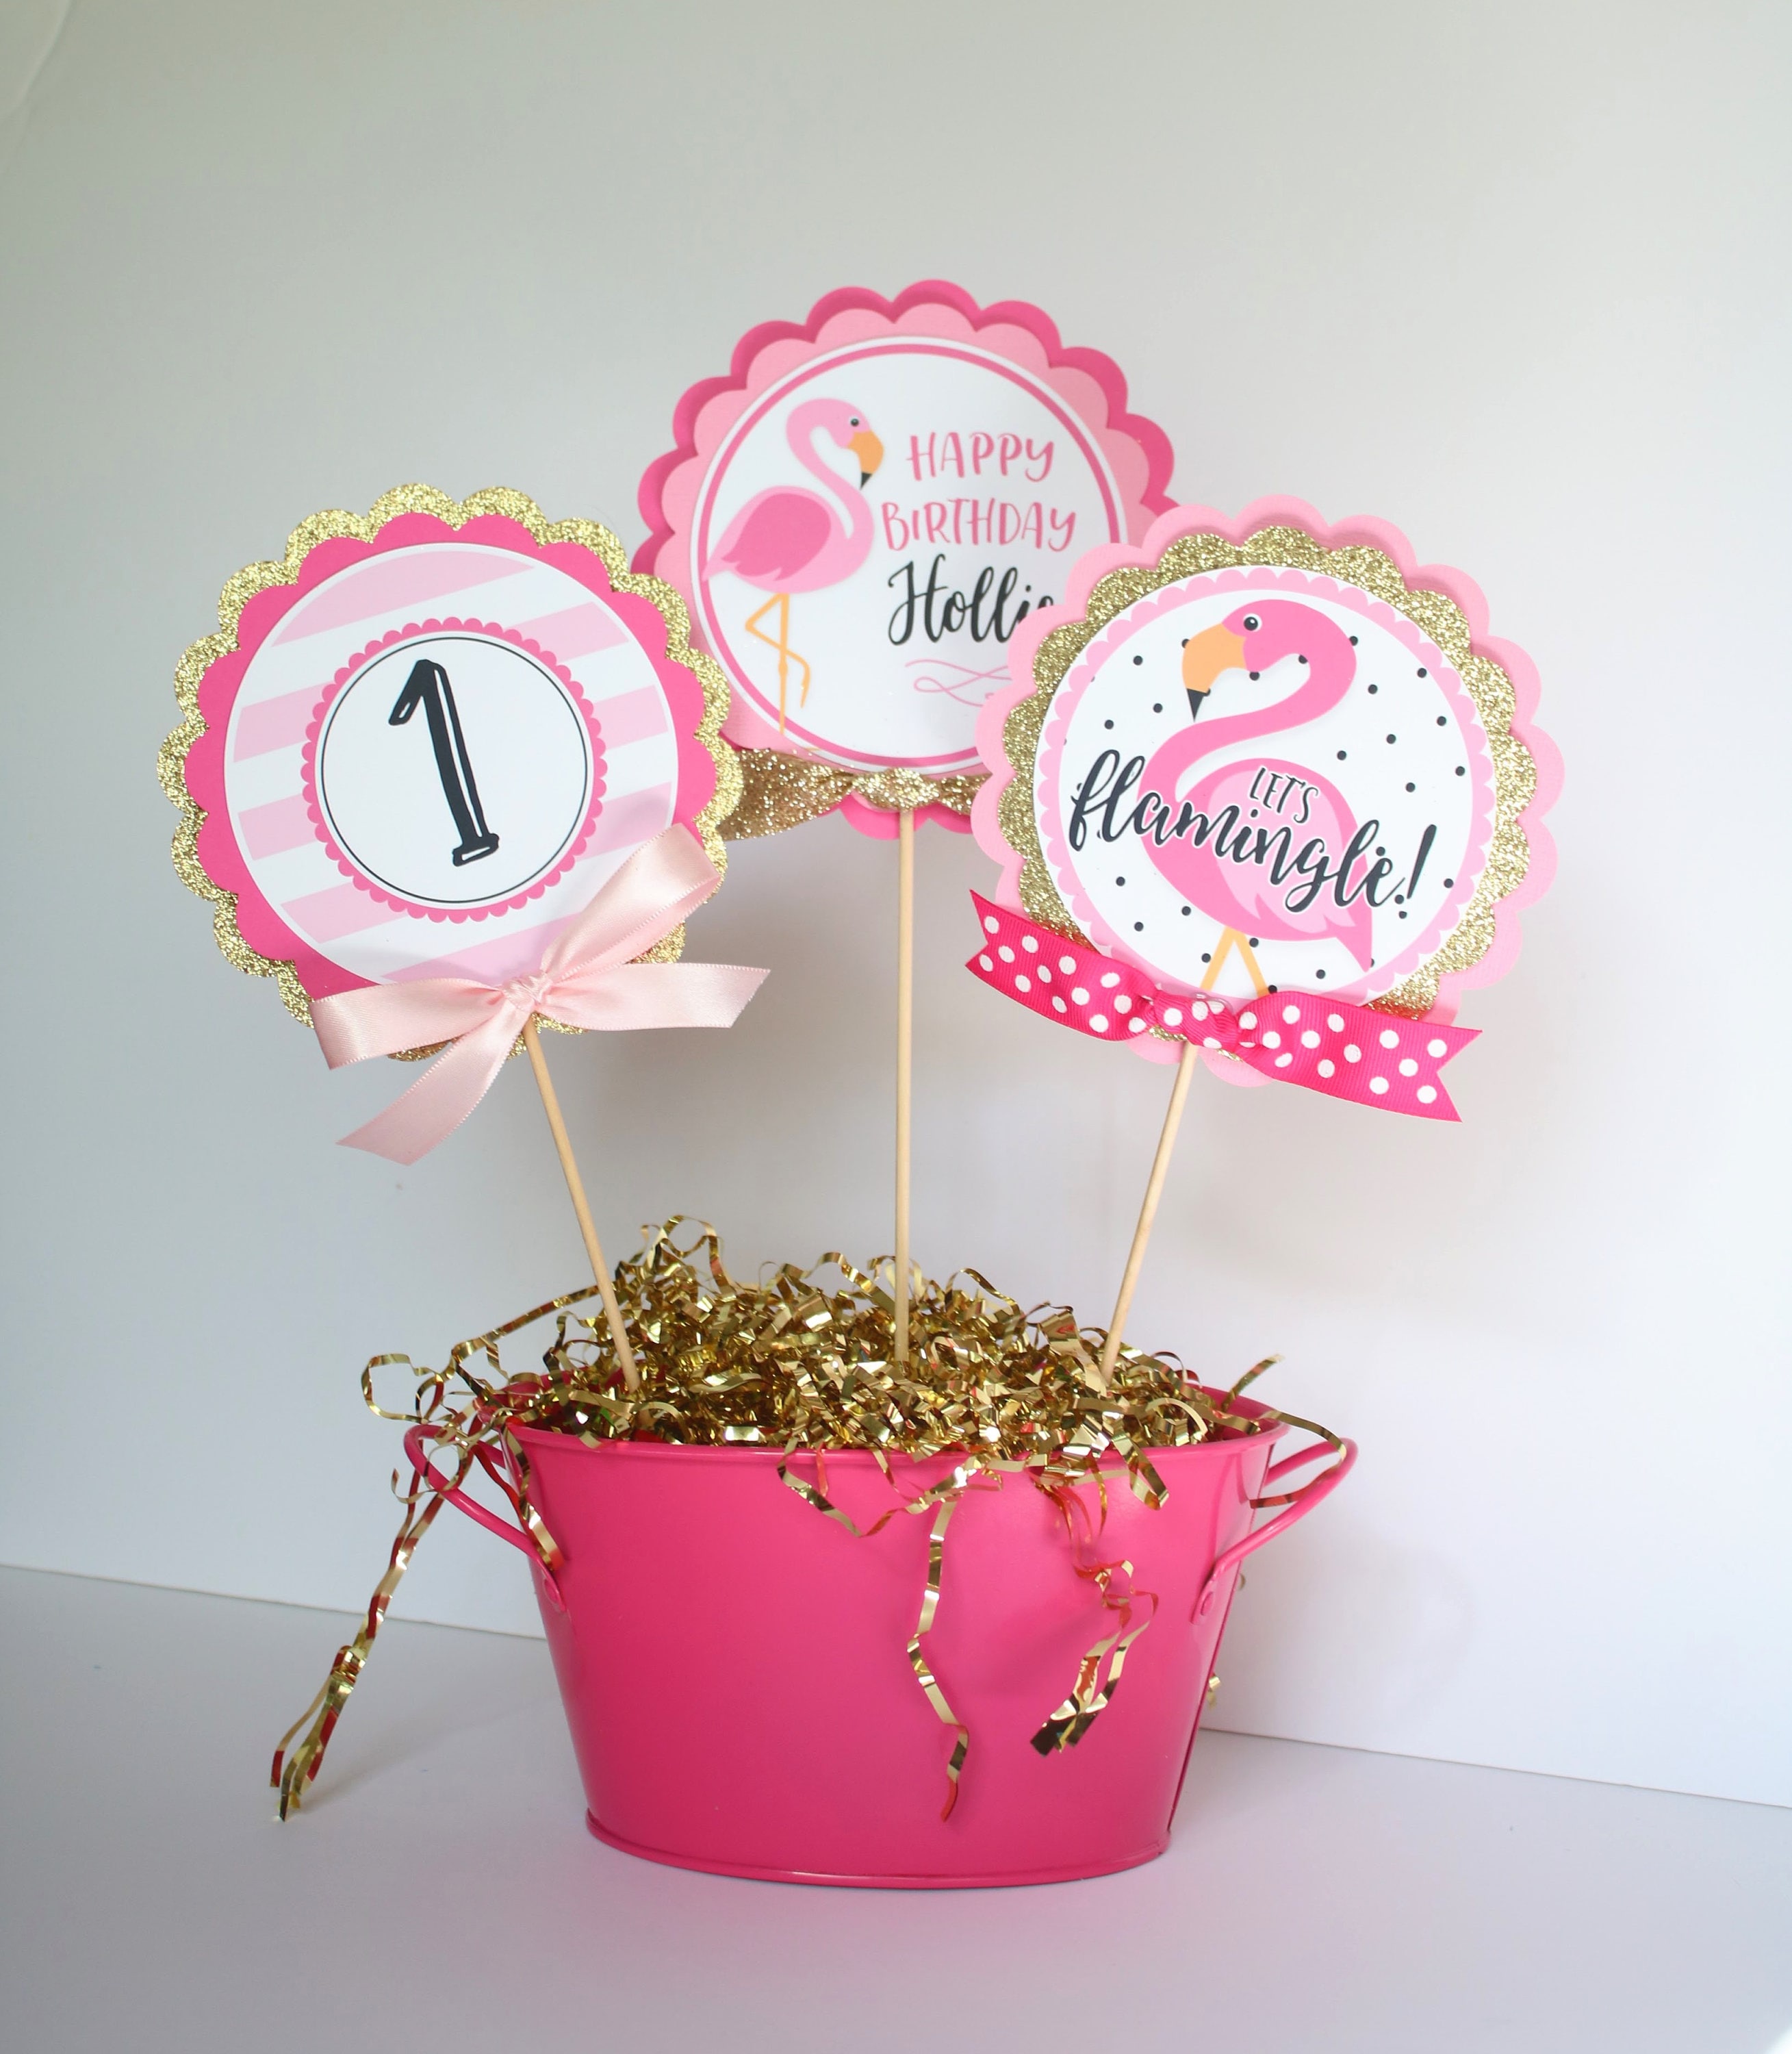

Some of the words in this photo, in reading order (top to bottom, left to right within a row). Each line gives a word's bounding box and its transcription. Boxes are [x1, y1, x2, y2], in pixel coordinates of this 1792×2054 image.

[906, 431, 1055, 483] HAPPY
[881, 497, 1077, 553] BIRTHDAY
[388, 659, 500, 867] 1
[1249, 767, 1319, 824] LET'S
[1068, 749, 1437, 920] flamingle!
